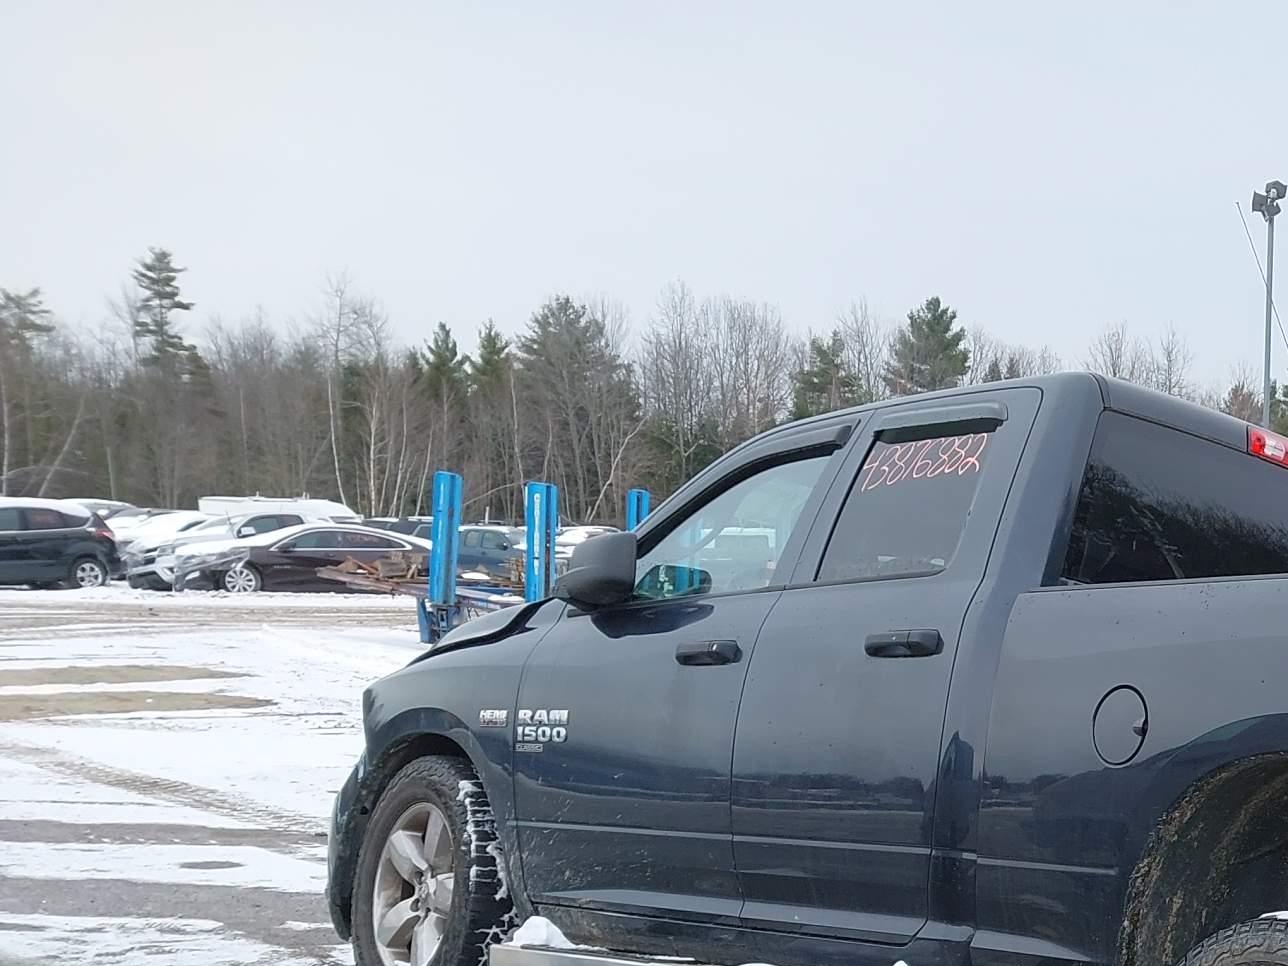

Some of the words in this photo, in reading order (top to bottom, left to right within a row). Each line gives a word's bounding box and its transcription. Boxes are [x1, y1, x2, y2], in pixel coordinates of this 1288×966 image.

[861, 432, 988, 493] 43876882
[517, 709, 569, 725] RAM
[516, 726, 567, 743] 1500
